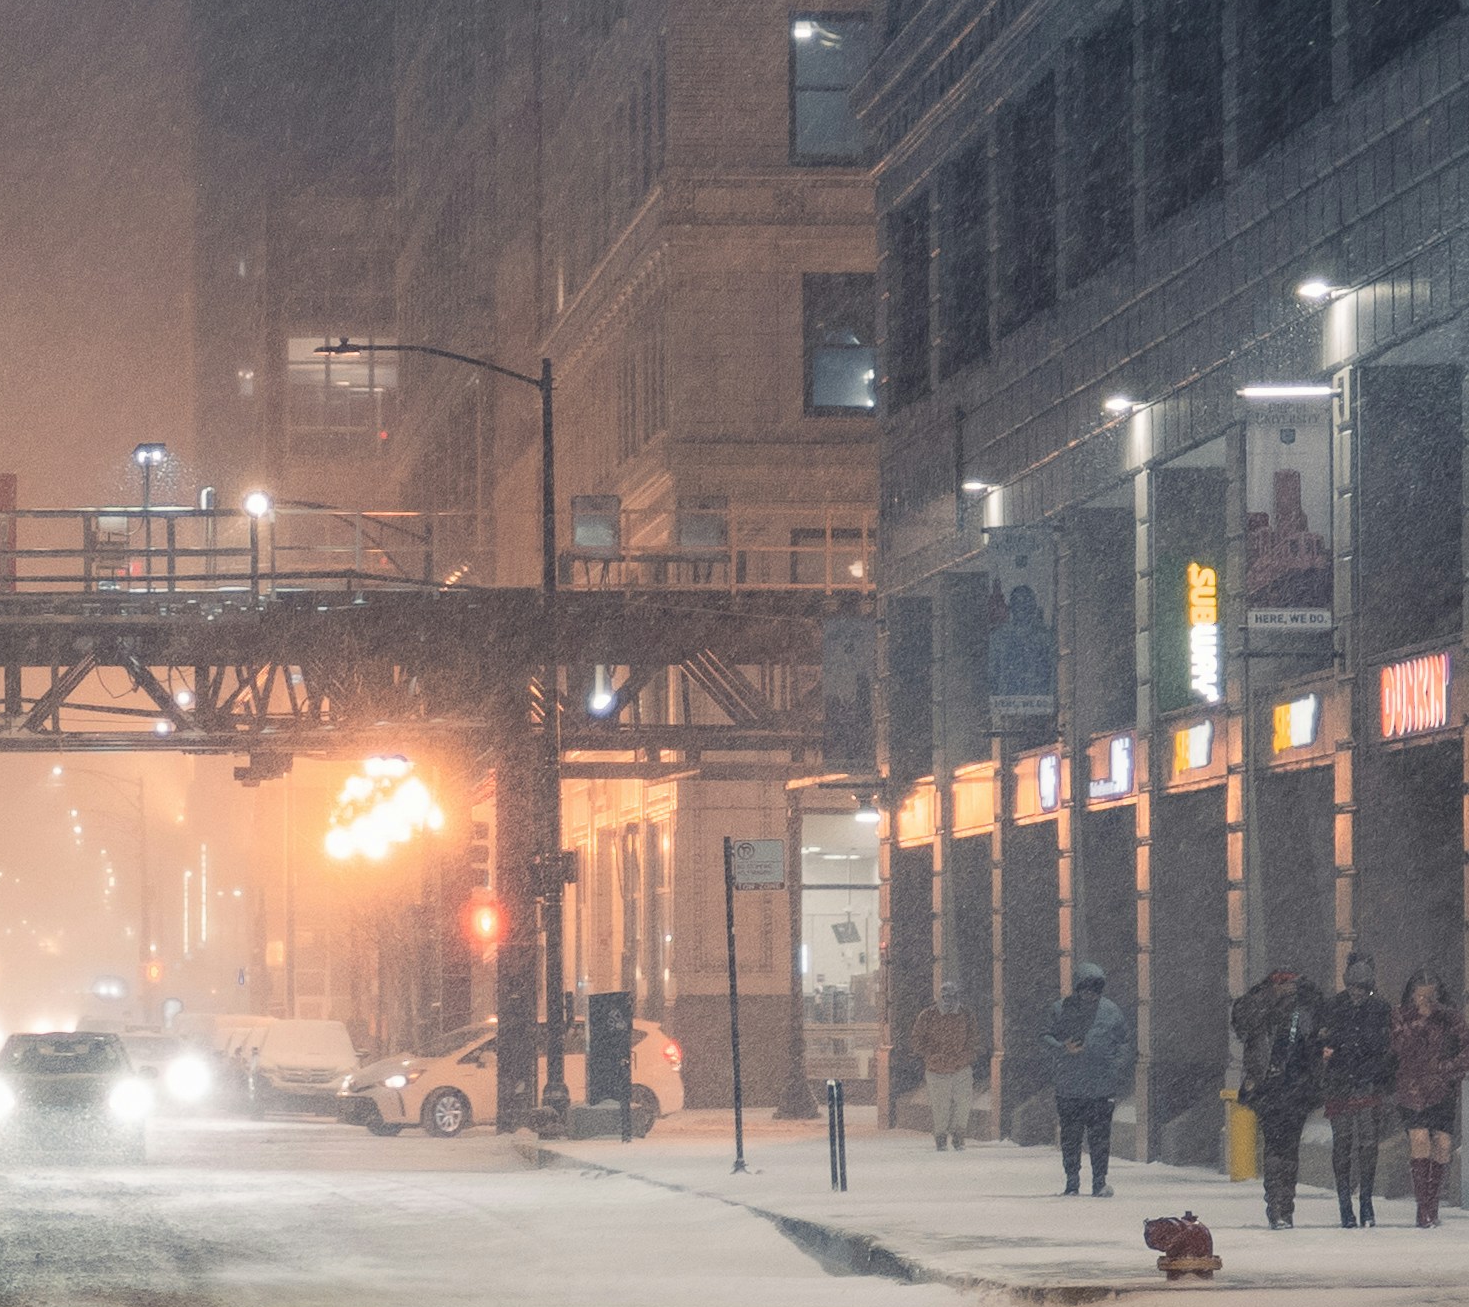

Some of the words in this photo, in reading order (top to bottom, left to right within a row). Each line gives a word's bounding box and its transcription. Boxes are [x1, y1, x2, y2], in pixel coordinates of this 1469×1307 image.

[1188, 562, 1219, 702] SUBWAY
[1254, 613, 1288, 624] HERE,
[1290, 613, 1307, 624] WE
[1309, 613, 1329, 624] DO.
